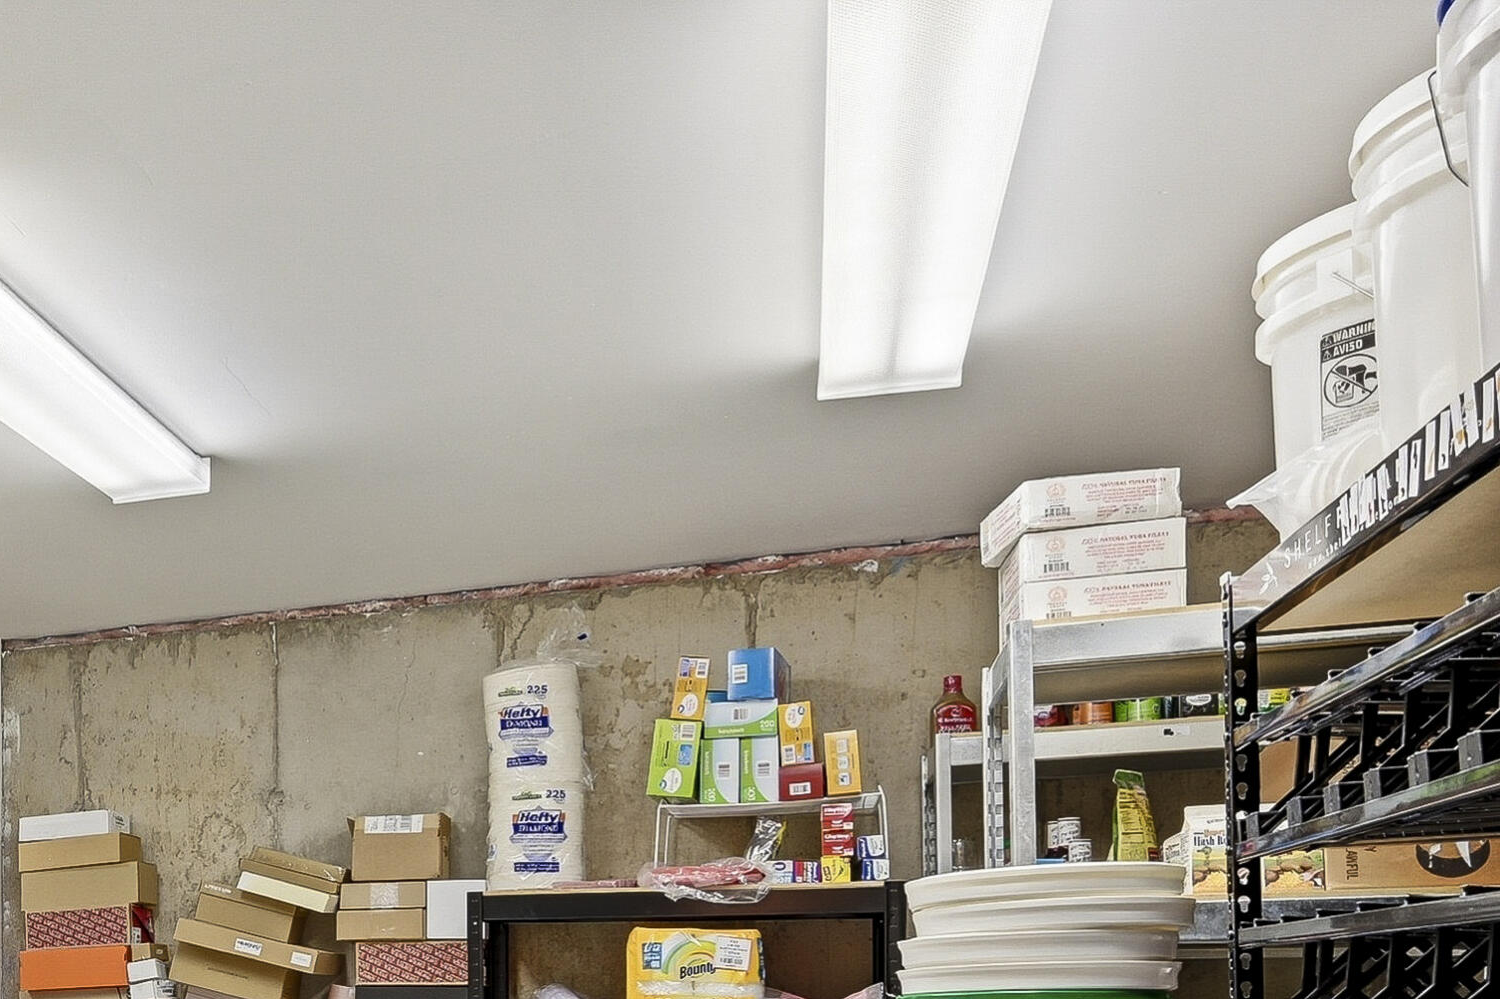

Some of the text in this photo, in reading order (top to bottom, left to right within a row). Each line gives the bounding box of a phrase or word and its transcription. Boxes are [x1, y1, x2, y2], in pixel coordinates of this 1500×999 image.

[1332, 318, 1376, 344] WARNIN
[1332, 339, 1364, 357] AVISO
[527, 684, 548, 695] 225
[503, 706, 544, 720] Hefty
[545, 789, 566, 799] 225
[519, 810, 560, 824] Hefty
[680, 961, 717, 980] Bounty
